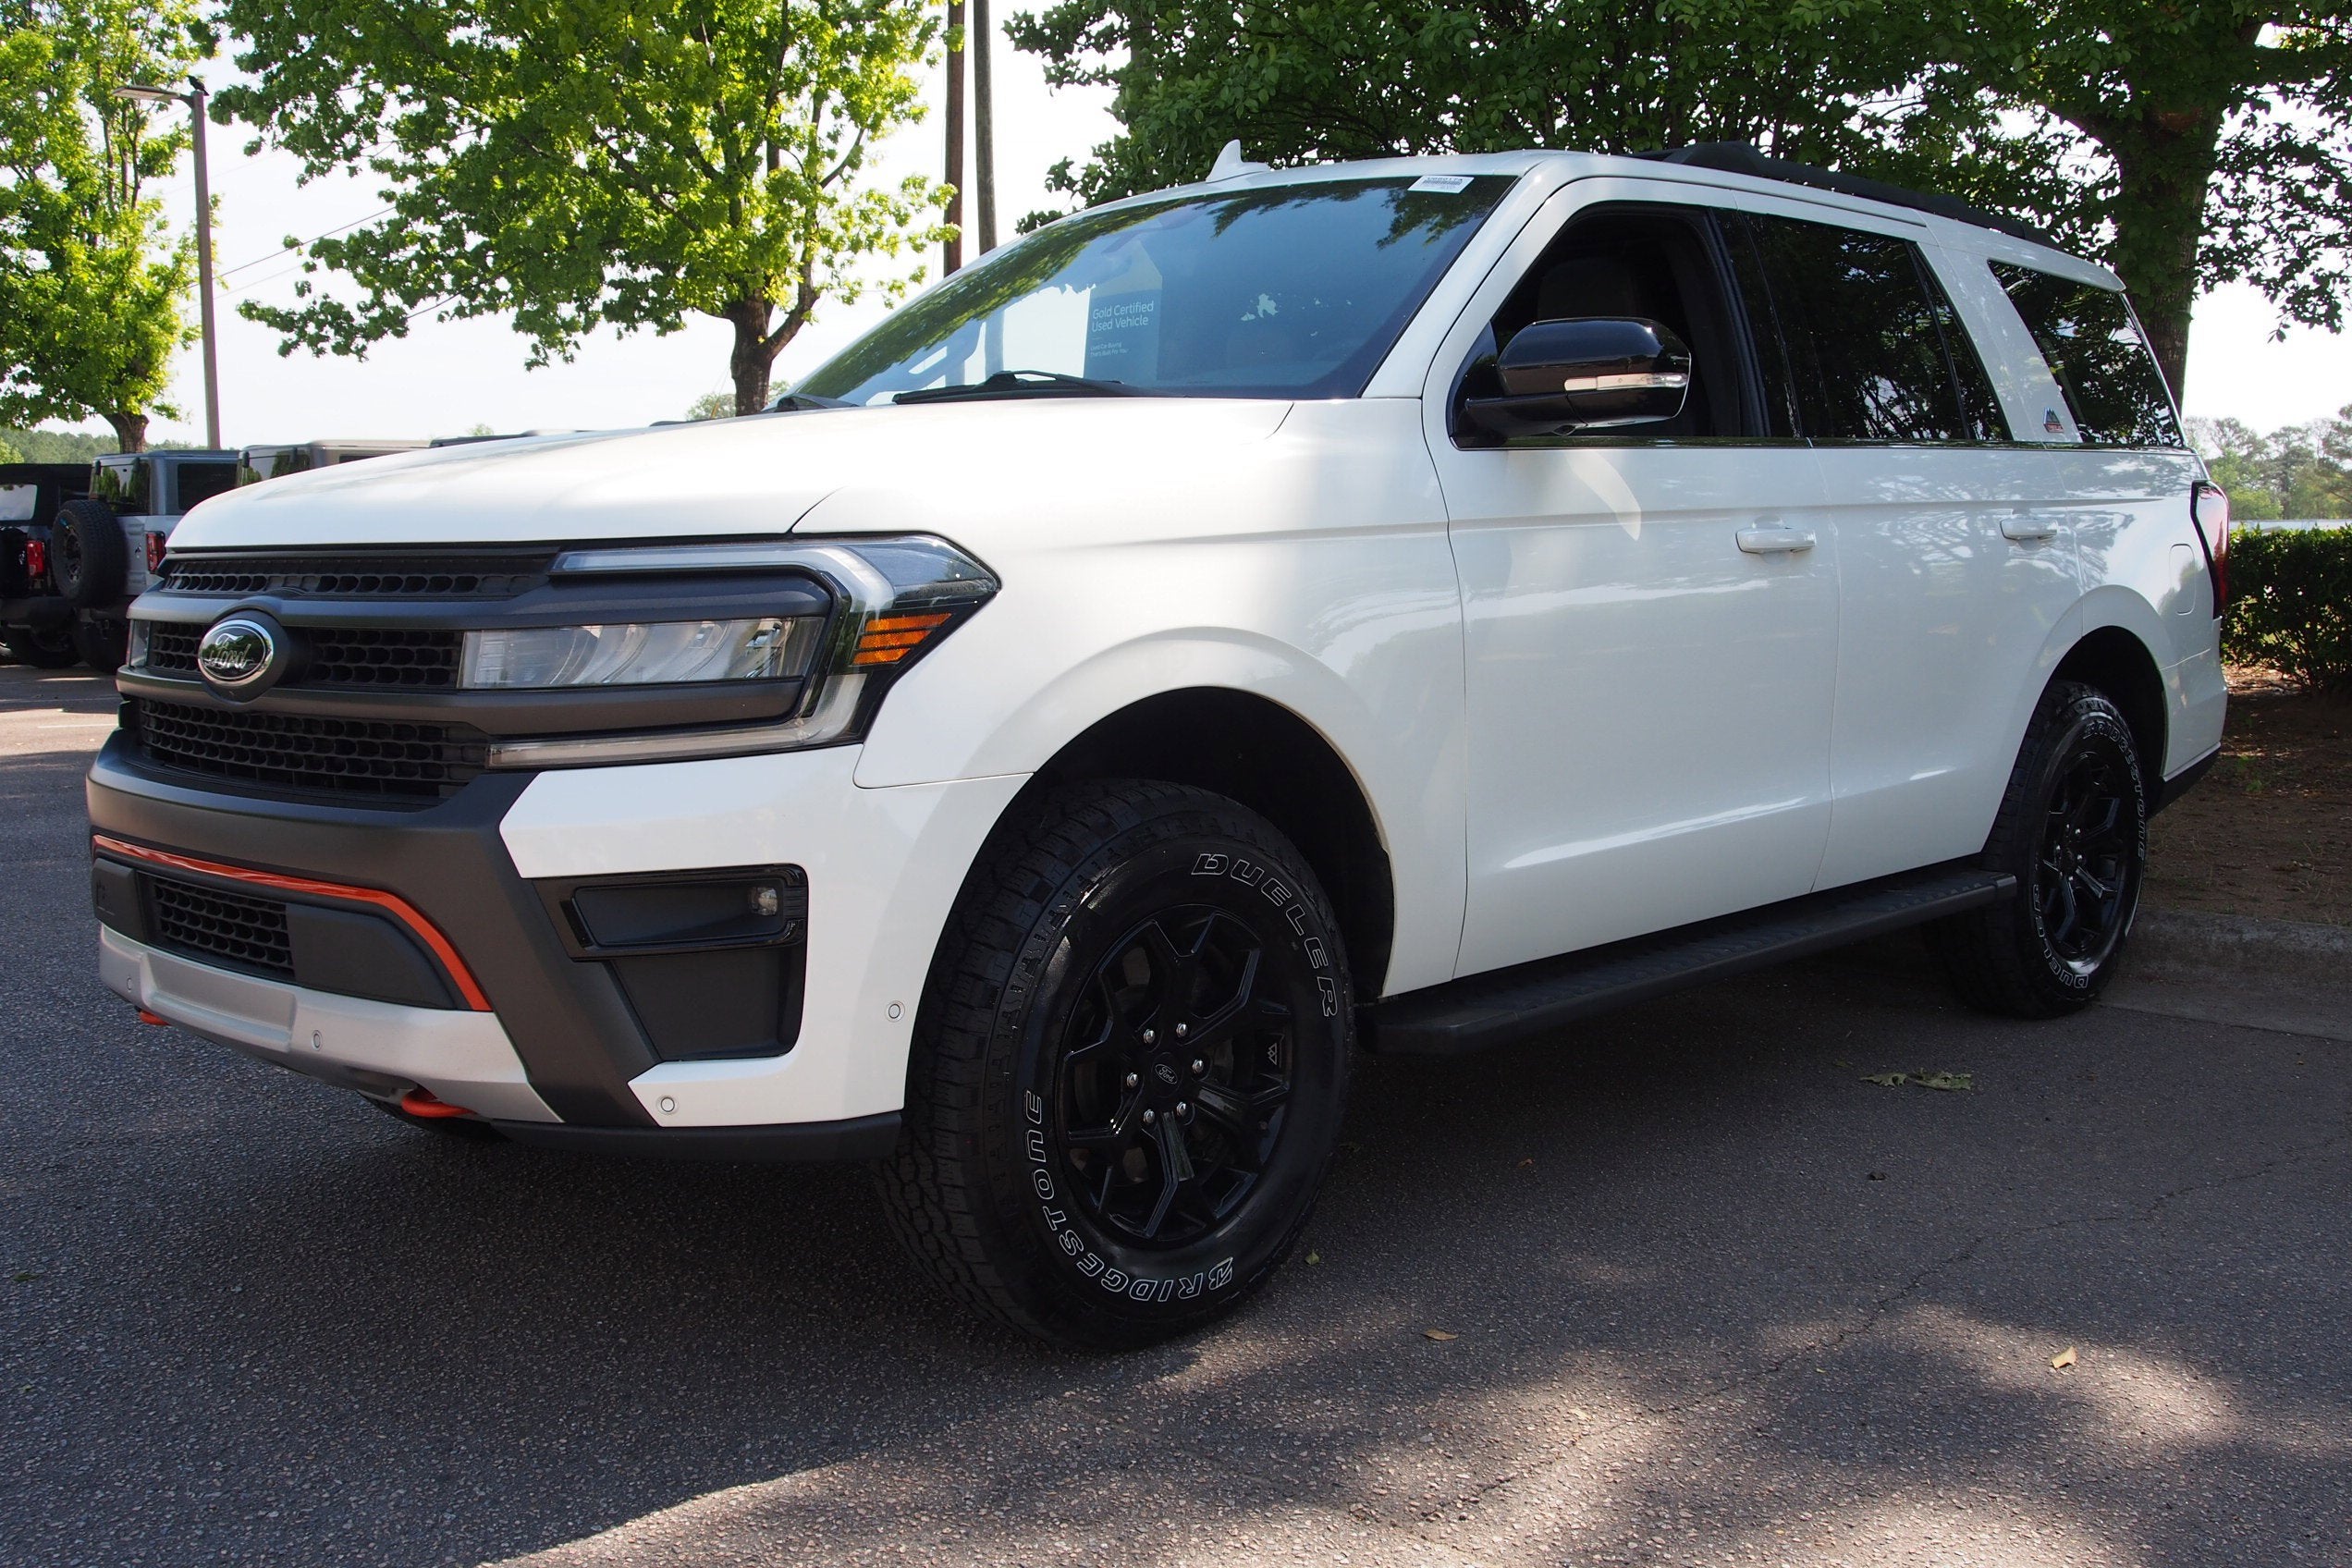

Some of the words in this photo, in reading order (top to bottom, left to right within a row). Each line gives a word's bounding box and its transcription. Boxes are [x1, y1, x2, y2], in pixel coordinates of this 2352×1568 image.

[1091, 320, 1113, 333] Used
[1115, 314, 1149, 328] Vehicle
[1093, 306, 1112, 320] Gold
[1113, 300, 1155, 316] Certified
[203, 632, 256, 670] Ford
[1191, 852, 1341, 1019] DUELER
[1158, 1065, 1176, 1084] Ford
[1023, 1089, 1234, 1304] BRIDGESTONE
